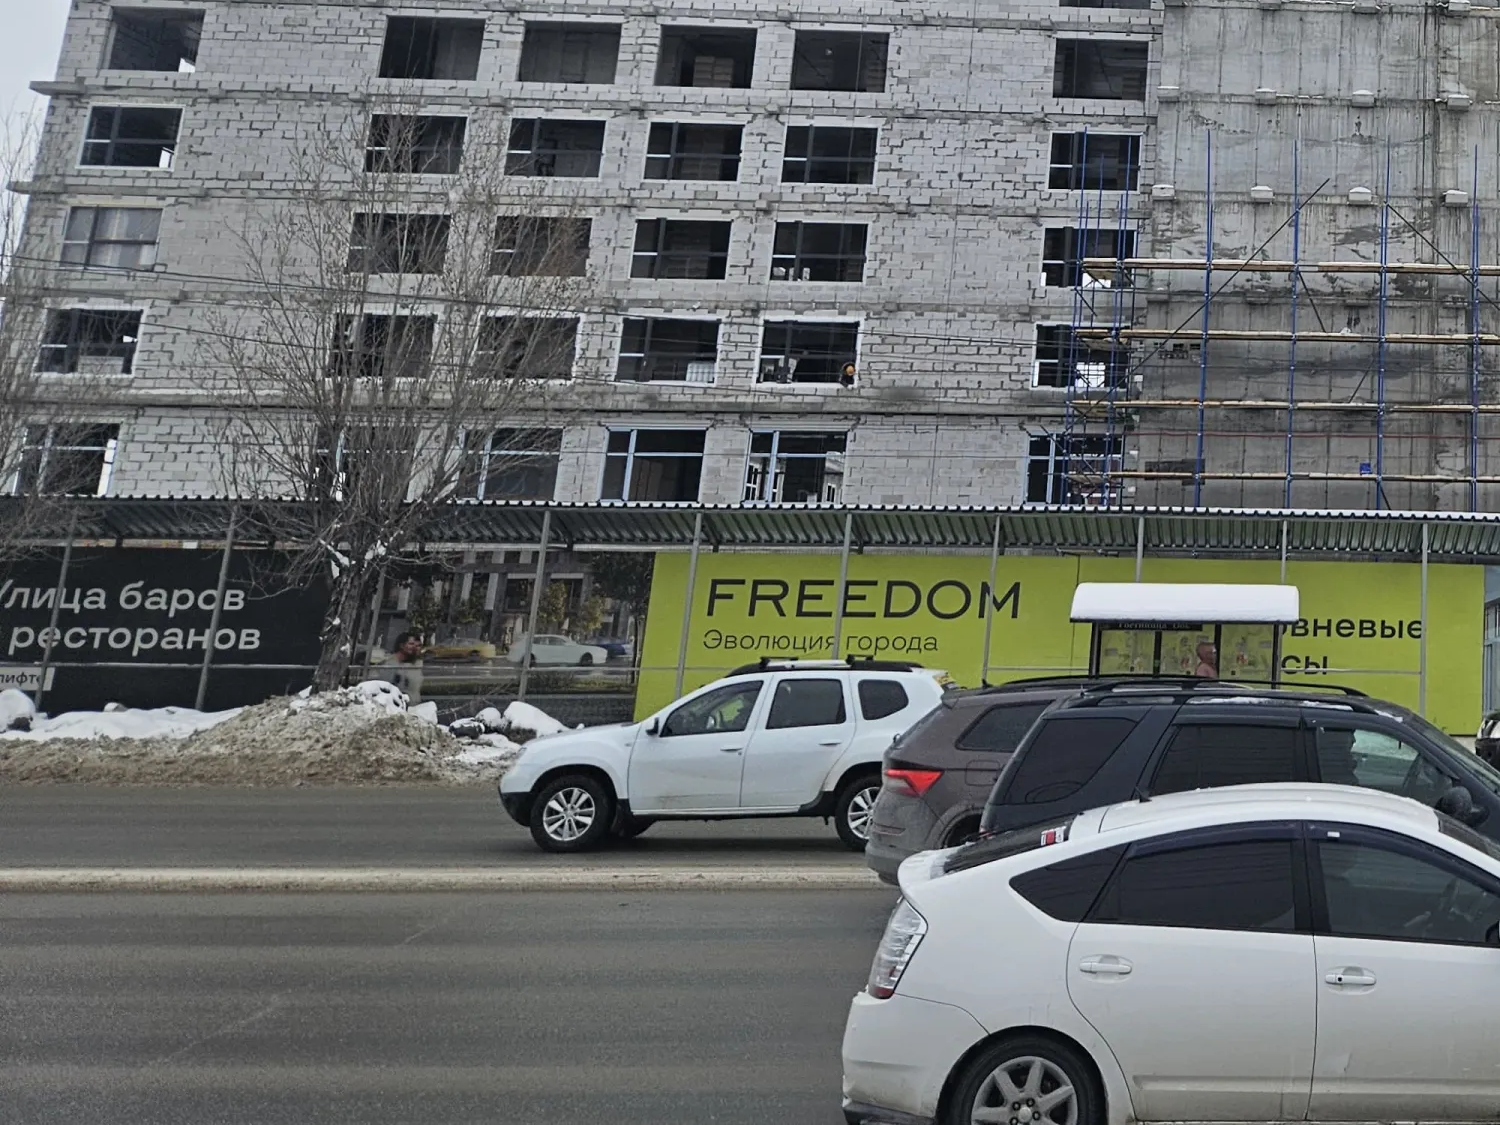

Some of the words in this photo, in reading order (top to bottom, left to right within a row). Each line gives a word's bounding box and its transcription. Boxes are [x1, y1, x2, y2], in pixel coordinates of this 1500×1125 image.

[119, 580, 246, 618] баров
[706, 578, 1021, 620] FREEDOM
[8, 626, 262, 657] ресторанов
[703, 630, 838, 653] Эволюция
[846, 635, 938, 656] города
[1282, 618, 1422, 640] вневые
